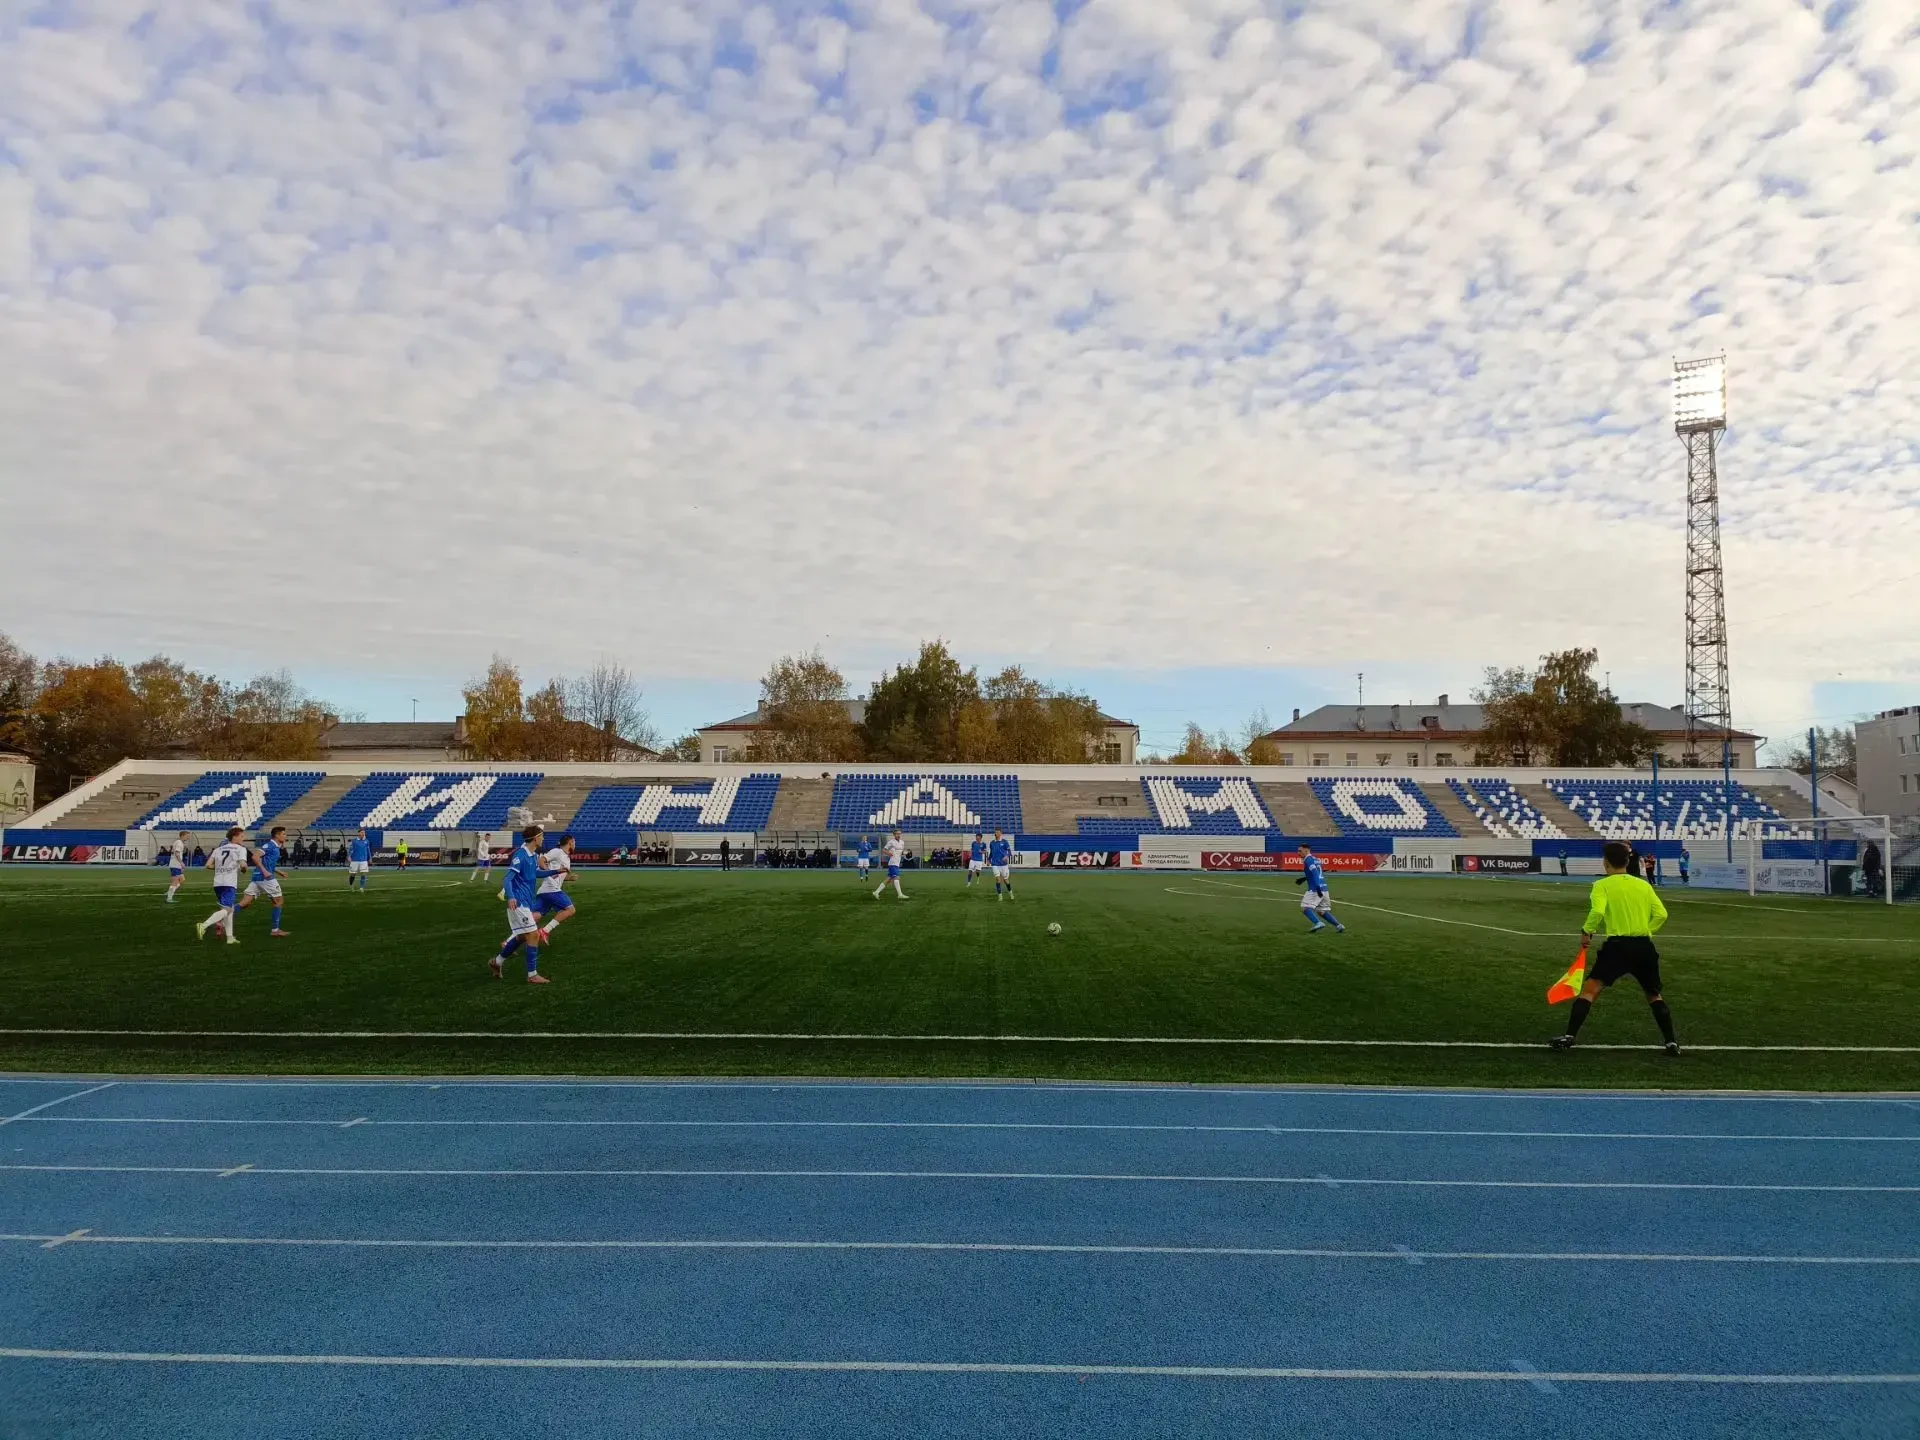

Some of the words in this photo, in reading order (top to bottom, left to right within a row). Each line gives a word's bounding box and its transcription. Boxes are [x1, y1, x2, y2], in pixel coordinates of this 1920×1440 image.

[12, 846, 67, 860] LEON
[101, 847, 116, 861] Red
[118, 847, 139, 860] finch
[221, 850, 230, 866] 7
[1052, 851, 1108, 866] LEON
[1233, 855, 1274, 864] альфатор
[1391, 854, 1407, 869] Red
[1410, 855, 1433, 869] finch
[1481, 859, 1496, 868] VK
[1497, 859, 1530, 869] Видео
